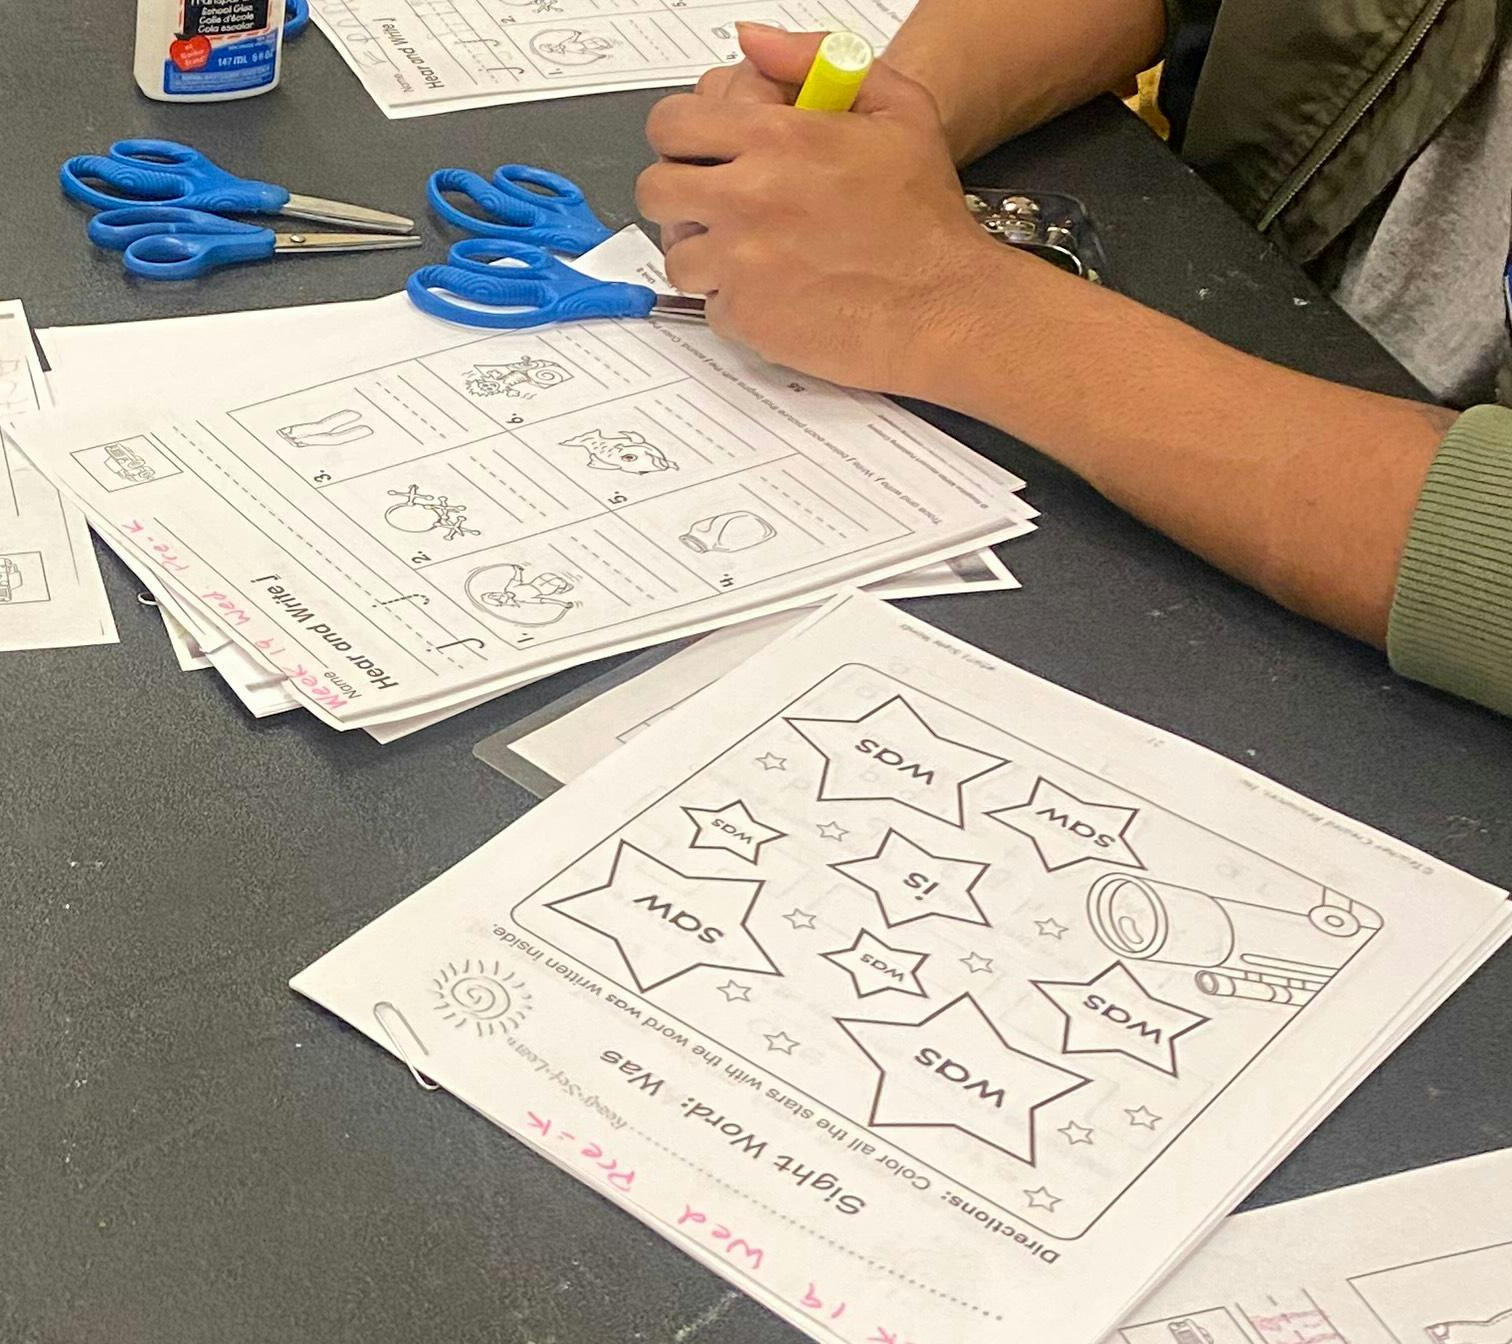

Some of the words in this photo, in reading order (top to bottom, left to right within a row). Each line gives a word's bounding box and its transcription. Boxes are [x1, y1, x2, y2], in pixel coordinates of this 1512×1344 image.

[382, 22, 410, 53] Write
[397, 46, 428, 64] and
[393, 72, 416, 94] Name
[416, 64, 446, 90] Hear
[505, 412, 525, 425] 6.
[608, 490, 628, 506] 5.
[719, 572, 731, 588] 4.
[313, 468, 332, 484] 3.
[411, 550, 432, 565] 2.
[517, 629, 535, 644] 1.
[266, 585, 315, 624] Write
[255, 637, 286, 656] 19
[309, 624, 353, 652] and
[282, 663, 348, 709] Week
[323, 670, 363, 700] Name
[346, 653, 400, 691] Hear
[854, 738, 936, 785] was
[710, 818, 753, 845] was
[903, 872, 939, 901] is
[1035, 807, 1116, 848] saw
[492, 923, 545, 963] inside.
[545, 957, 604, 997] written
[633, 894, 725, 944] saw
[859, 953, 907, 983] was
[1082, 993, 1162, 1045] was
[604, 992, 642, 1019] was
[640, 1015, 689, 1047] word
[599, 1050, 666, 1097] Was
[692, 1043, 723, 1068] the
[723, 1062, 763, 1092] with
[914, 1047, 1006, 1109] was
[764, 1087, 815, 1120] stars
[680, 1096, 769, 1160] Word:
[816, 1117, 848, 1142] the
[846, 1138, 877, 1156] all
[773, 1155, 866, 1216] Sight
[875, 1154, 932, 1191] Color
[676, 1203, 764, 1270] Wed
[940, 1190, 1062, 1265] Directions:
[800, 1281, 846, 1320] 19
